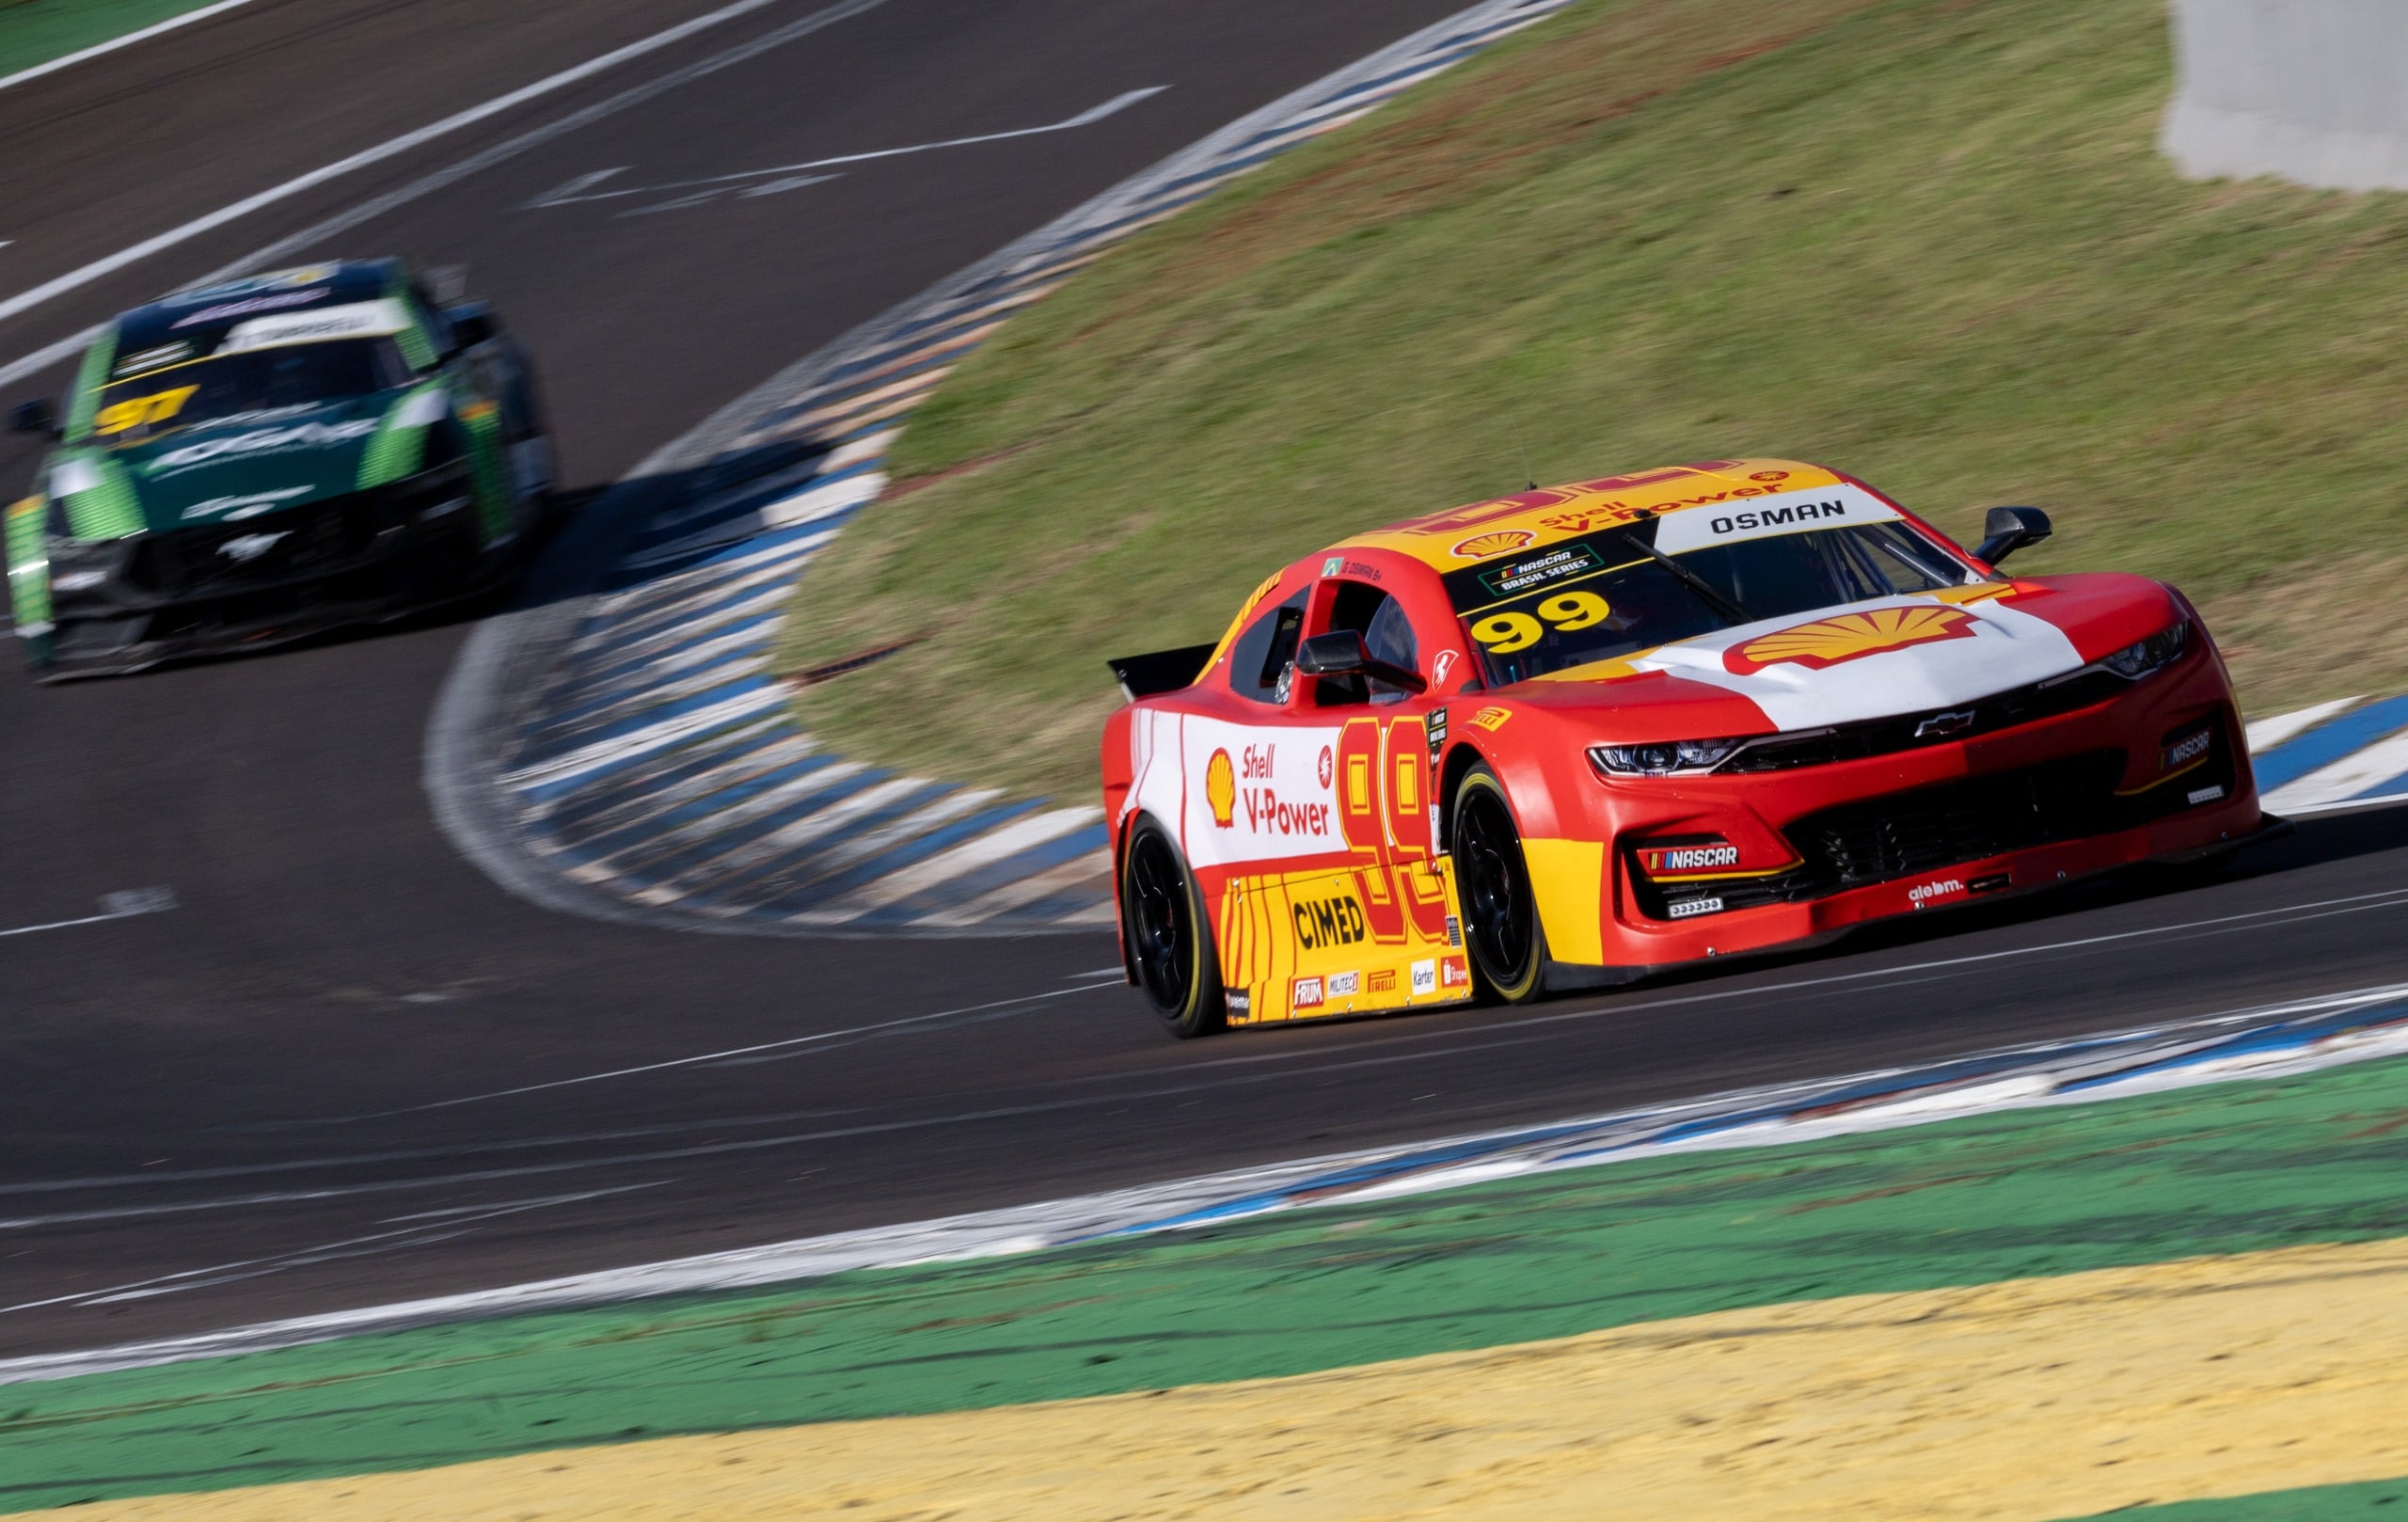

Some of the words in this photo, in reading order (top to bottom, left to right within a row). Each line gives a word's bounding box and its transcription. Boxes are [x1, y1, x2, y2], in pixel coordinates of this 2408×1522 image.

[1540, 500, 1627, 527] Shell
[1552, 482, 1785, 532] V-Power
[1709, 499, 1846, 534] OSMAN
[1500, 571, 1547, 592] BRASIL
[1546, 558, 1590, 578] SERIES
[1518, 551, 1572, 574] NASCAR
[1470, 590, 1610, 654] 99
[1242, 742, 1275, 779] Shell
[2172, 731, 2210, 765] NASCAR
[1243, 788, 1329, 836] V-Power
[1336, 716, 1450, 946] 99
[1671, 846, 1738, 869] NASCAR
[1293, 896, 1366, 950] CIMED
[1293, 977, 1323, 1007] FRUM
[1367, 969, 1396, 993] PIRELLI
[1413, 970, 1434, 987] Karter
[1450, 966, 1467, 984] Shopee
